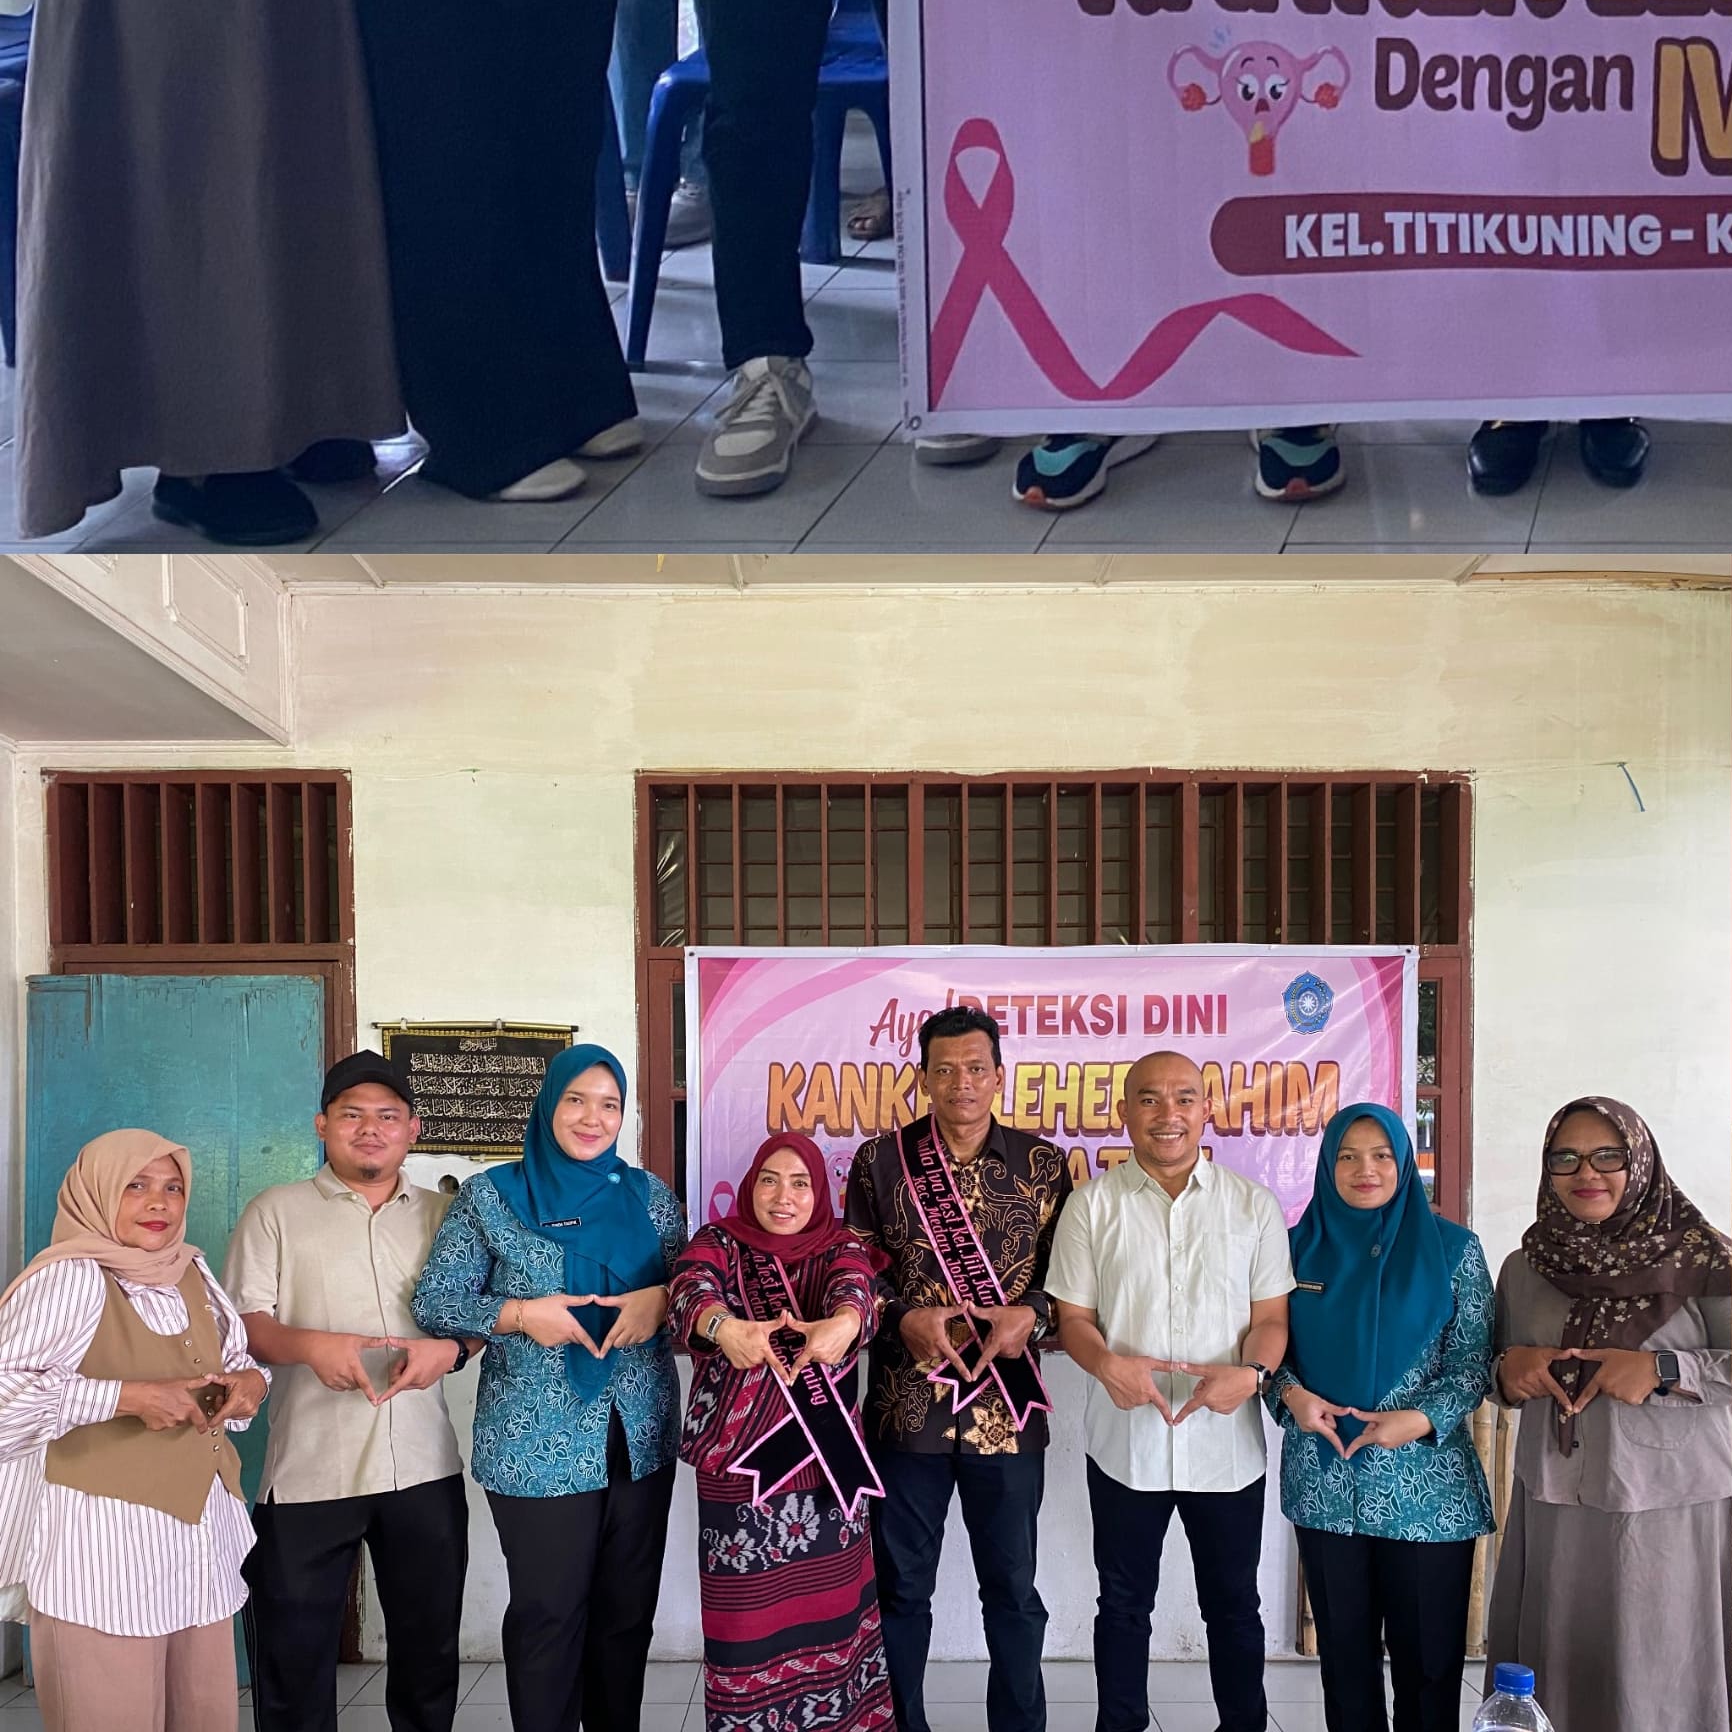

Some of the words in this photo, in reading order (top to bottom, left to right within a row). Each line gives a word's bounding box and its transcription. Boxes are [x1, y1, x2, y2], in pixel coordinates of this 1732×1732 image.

[1375, 37, 1635, 132] Dengan
[1143, 994, 1227, 1036] DINI
[1200, 1060, 1341, 1138] AHIM
[926, 1168, 946, 1193] Iva
[936, 1193, 964, 1224] Test
[755, 1263, 783, 1289] Test
[924, 1205, 952, 1254] Medan
[945, 1257, 975, 1302] Johor
